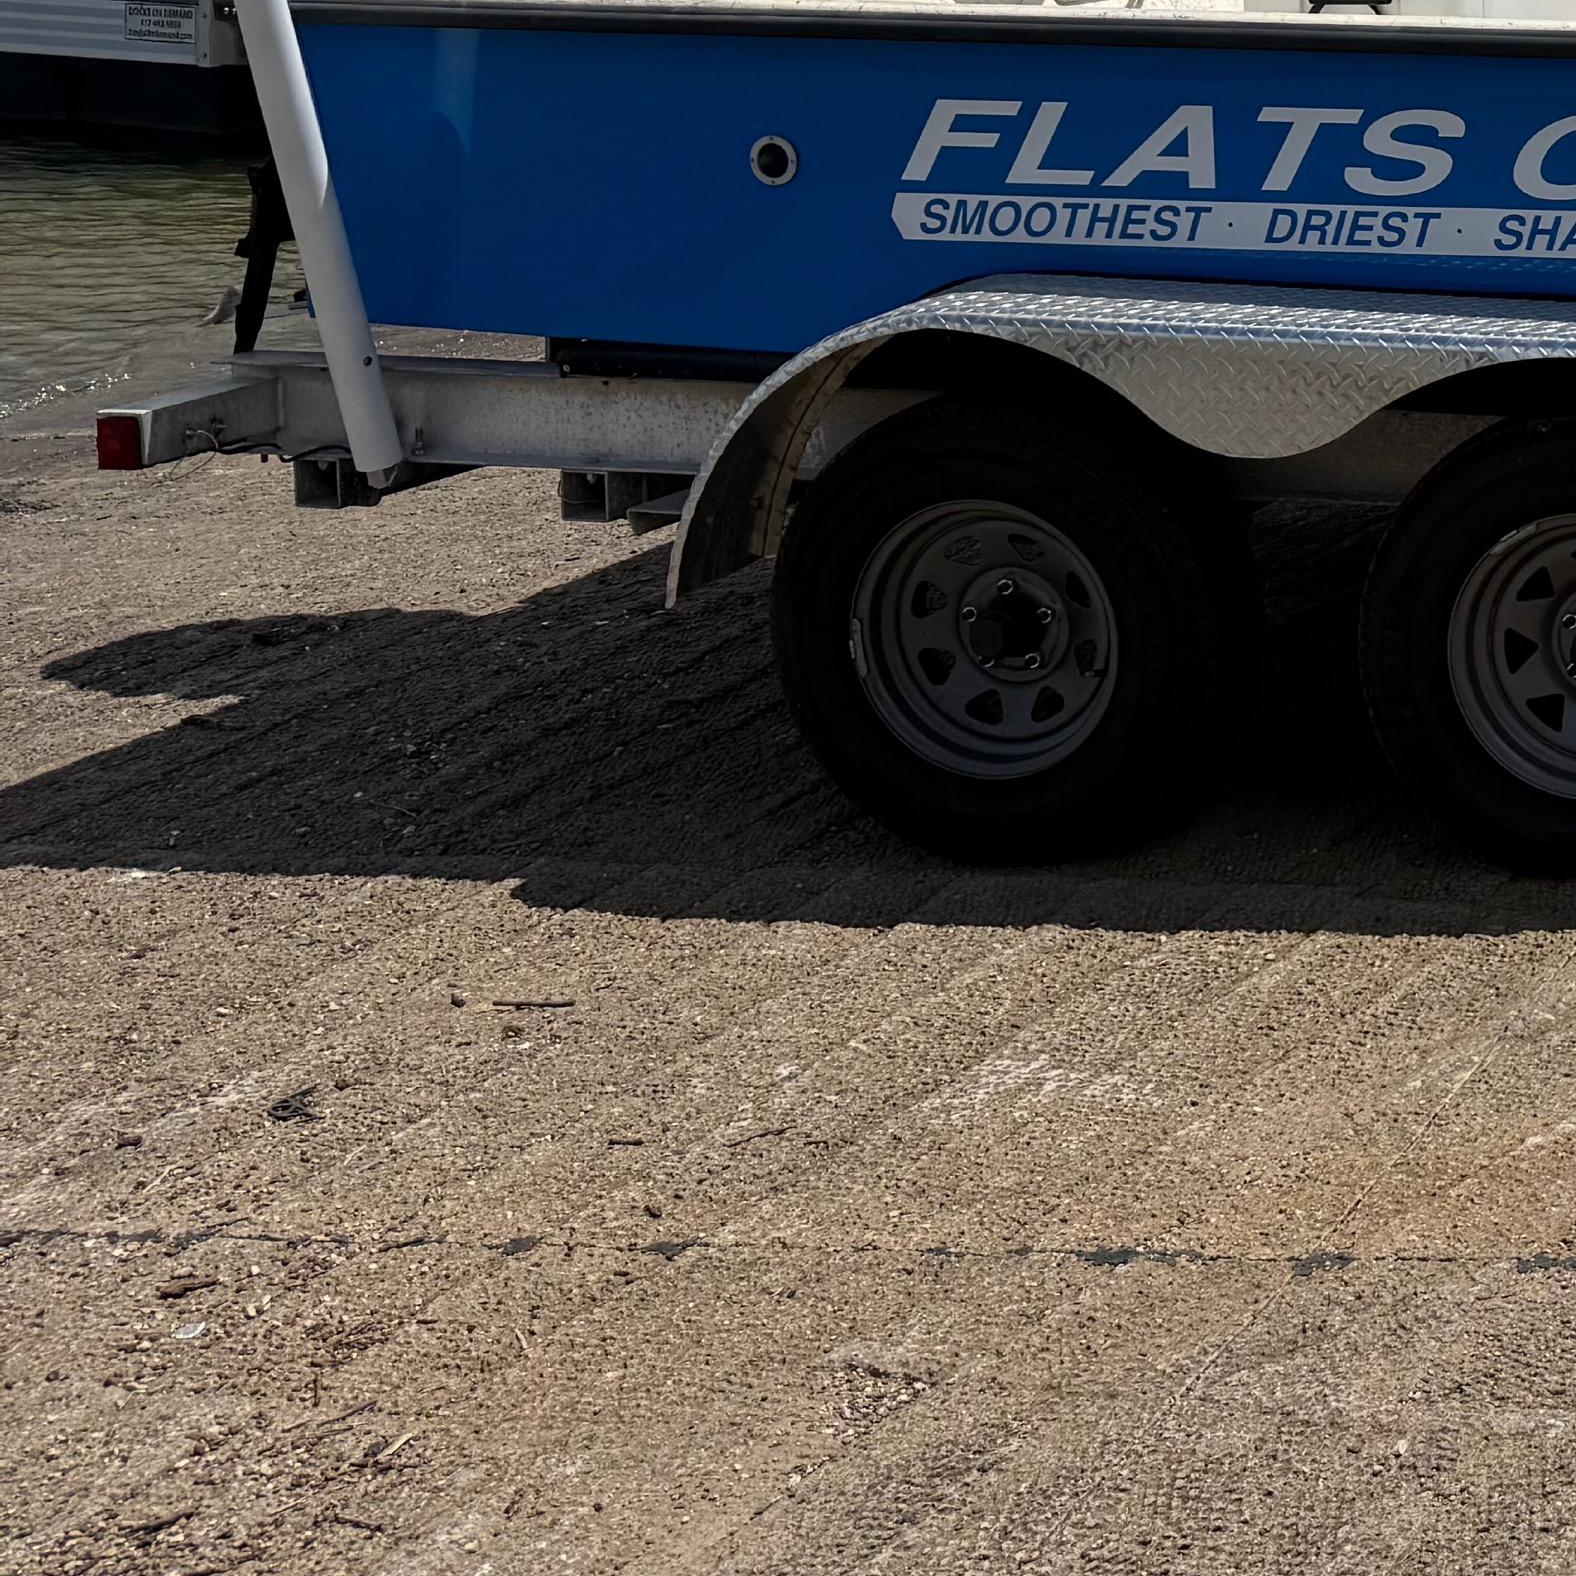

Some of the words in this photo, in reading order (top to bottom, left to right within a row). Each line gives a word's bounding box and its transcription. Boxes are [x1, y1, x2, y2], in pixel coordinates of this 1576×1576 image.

[901, 98, 1466, 197] FLATS
[919, 198, 1210, 242] SMOOTHEST
[1264, 206, 1441, 250] DRIEST
